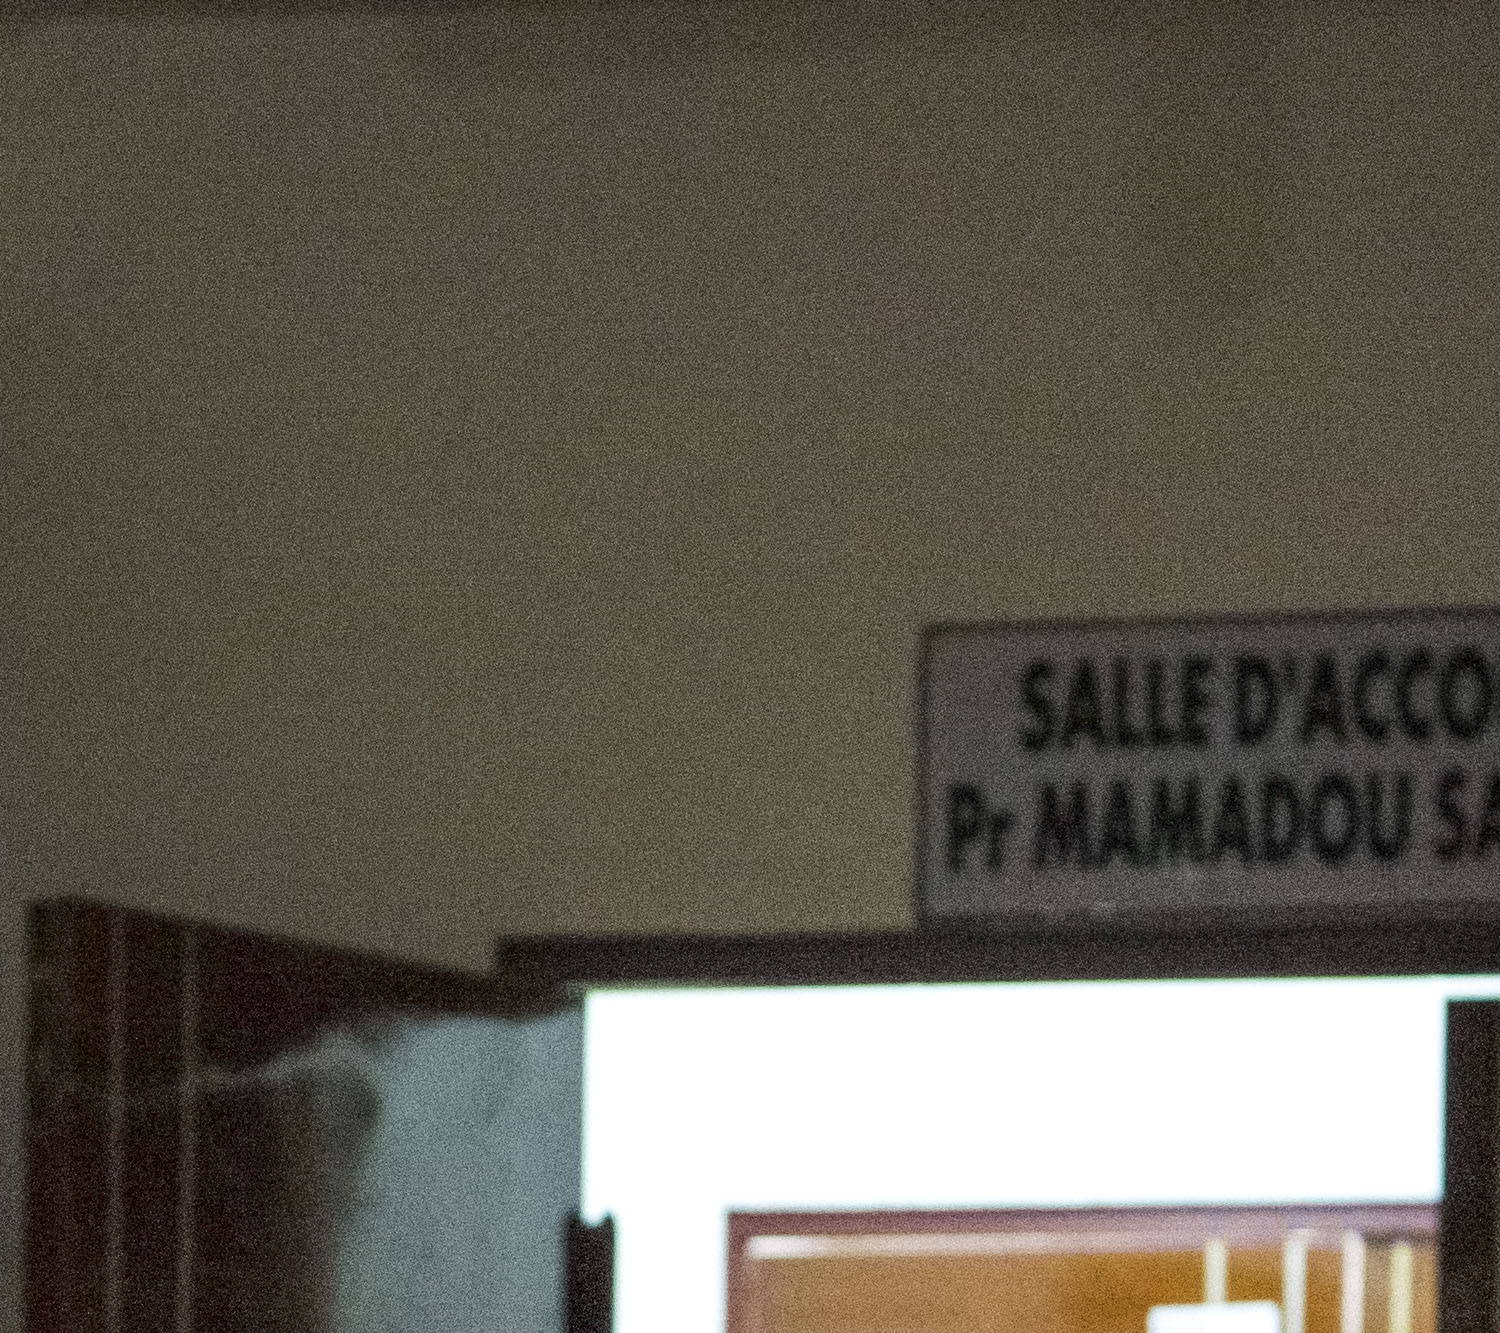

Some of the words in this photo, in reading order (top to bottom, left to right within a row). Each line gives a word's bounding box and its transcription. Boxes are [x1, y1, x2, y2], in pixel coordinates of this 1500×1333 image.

[1019, 652, 1212, 752] SALLE
[945, 782, 1008, 873] Pr
[1035, 768, 1411, 870] MAMADOU
